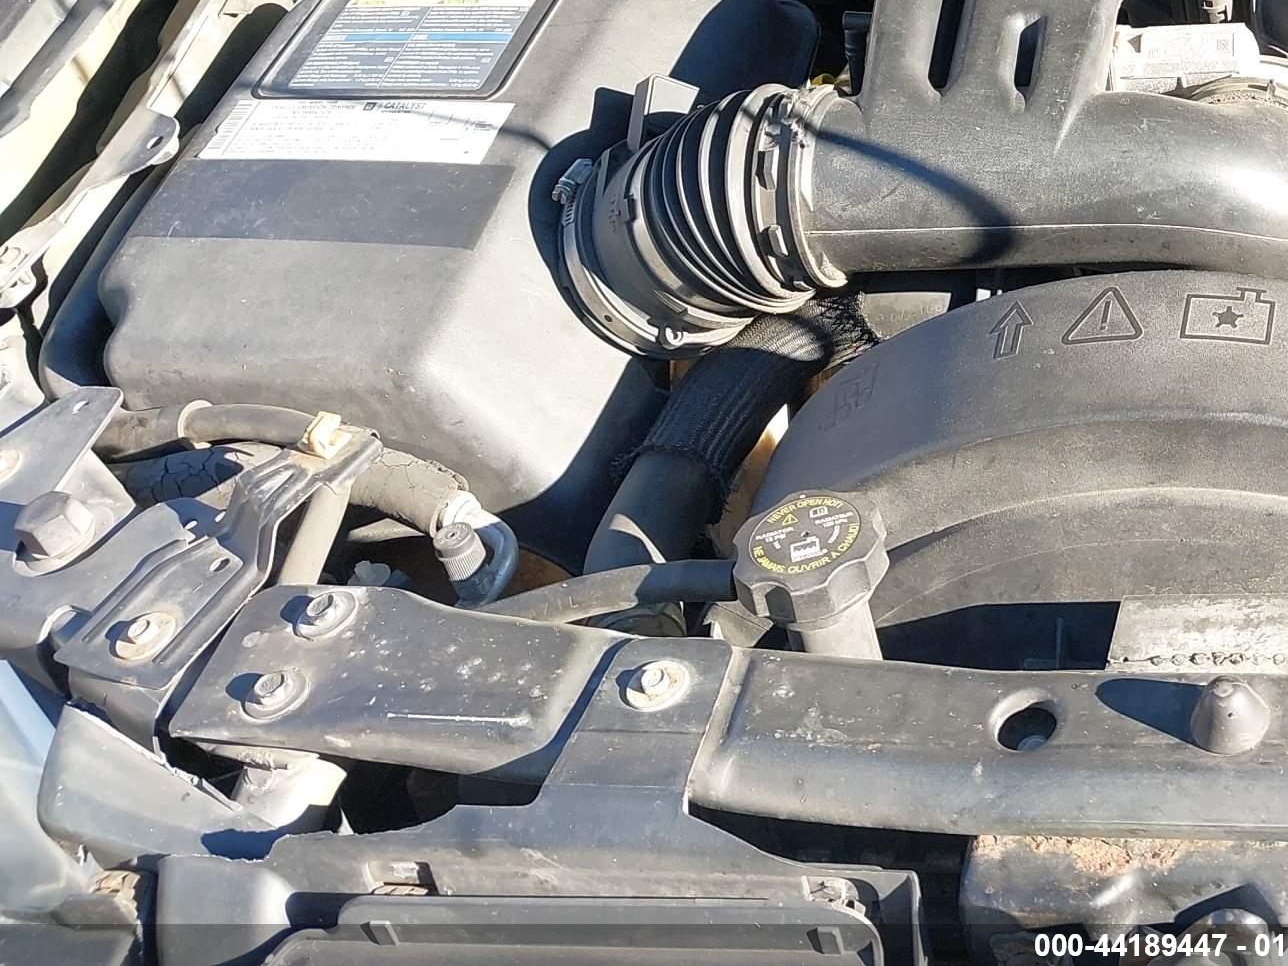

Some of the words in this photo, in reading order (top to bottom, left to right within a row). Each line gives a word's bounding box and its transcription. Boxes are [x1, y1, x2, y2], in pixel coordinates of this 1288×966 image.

[766, 505, 797, 523] NEVER
[797, 498, 823, 509] OPEN
[756, 526, 794, 541] RADIATOR
[753, 545, 765, 558] NE
[757, 557, 786, 572] JAMAIS
[787, 556, 831, 574] OUVRIR
